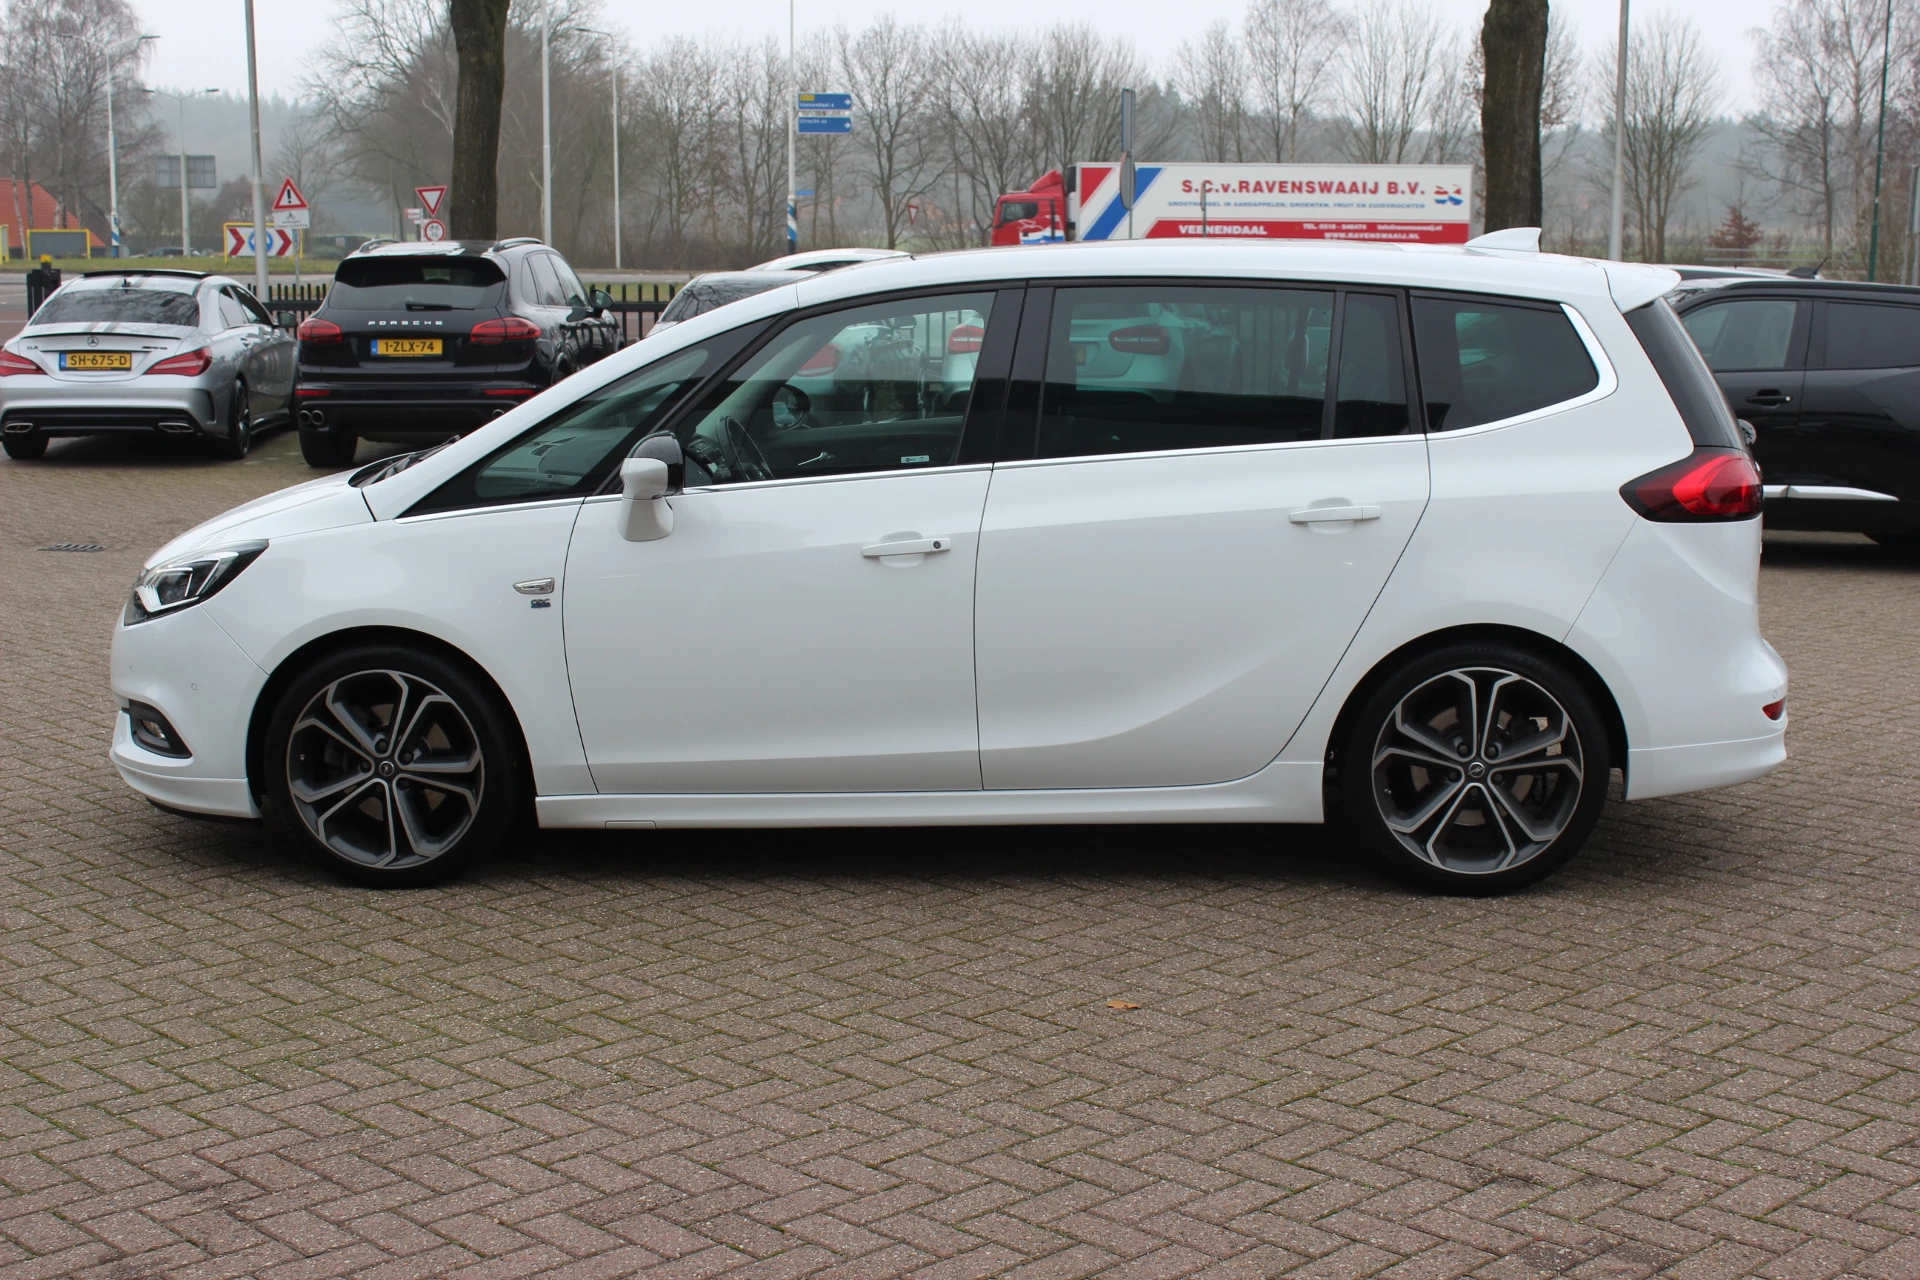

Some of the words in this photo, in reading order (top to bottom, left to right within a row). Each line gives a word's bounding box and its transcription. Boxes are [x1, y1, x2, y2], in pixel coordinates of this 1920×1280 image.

[1387, 181, 1425, 195] B.V.
[1178, 225, 1268, 235] VEENENDAAL
[384, 341, 434, 352] 1-ZLX-74
[70, 355, 128, 365] SH-675-D
